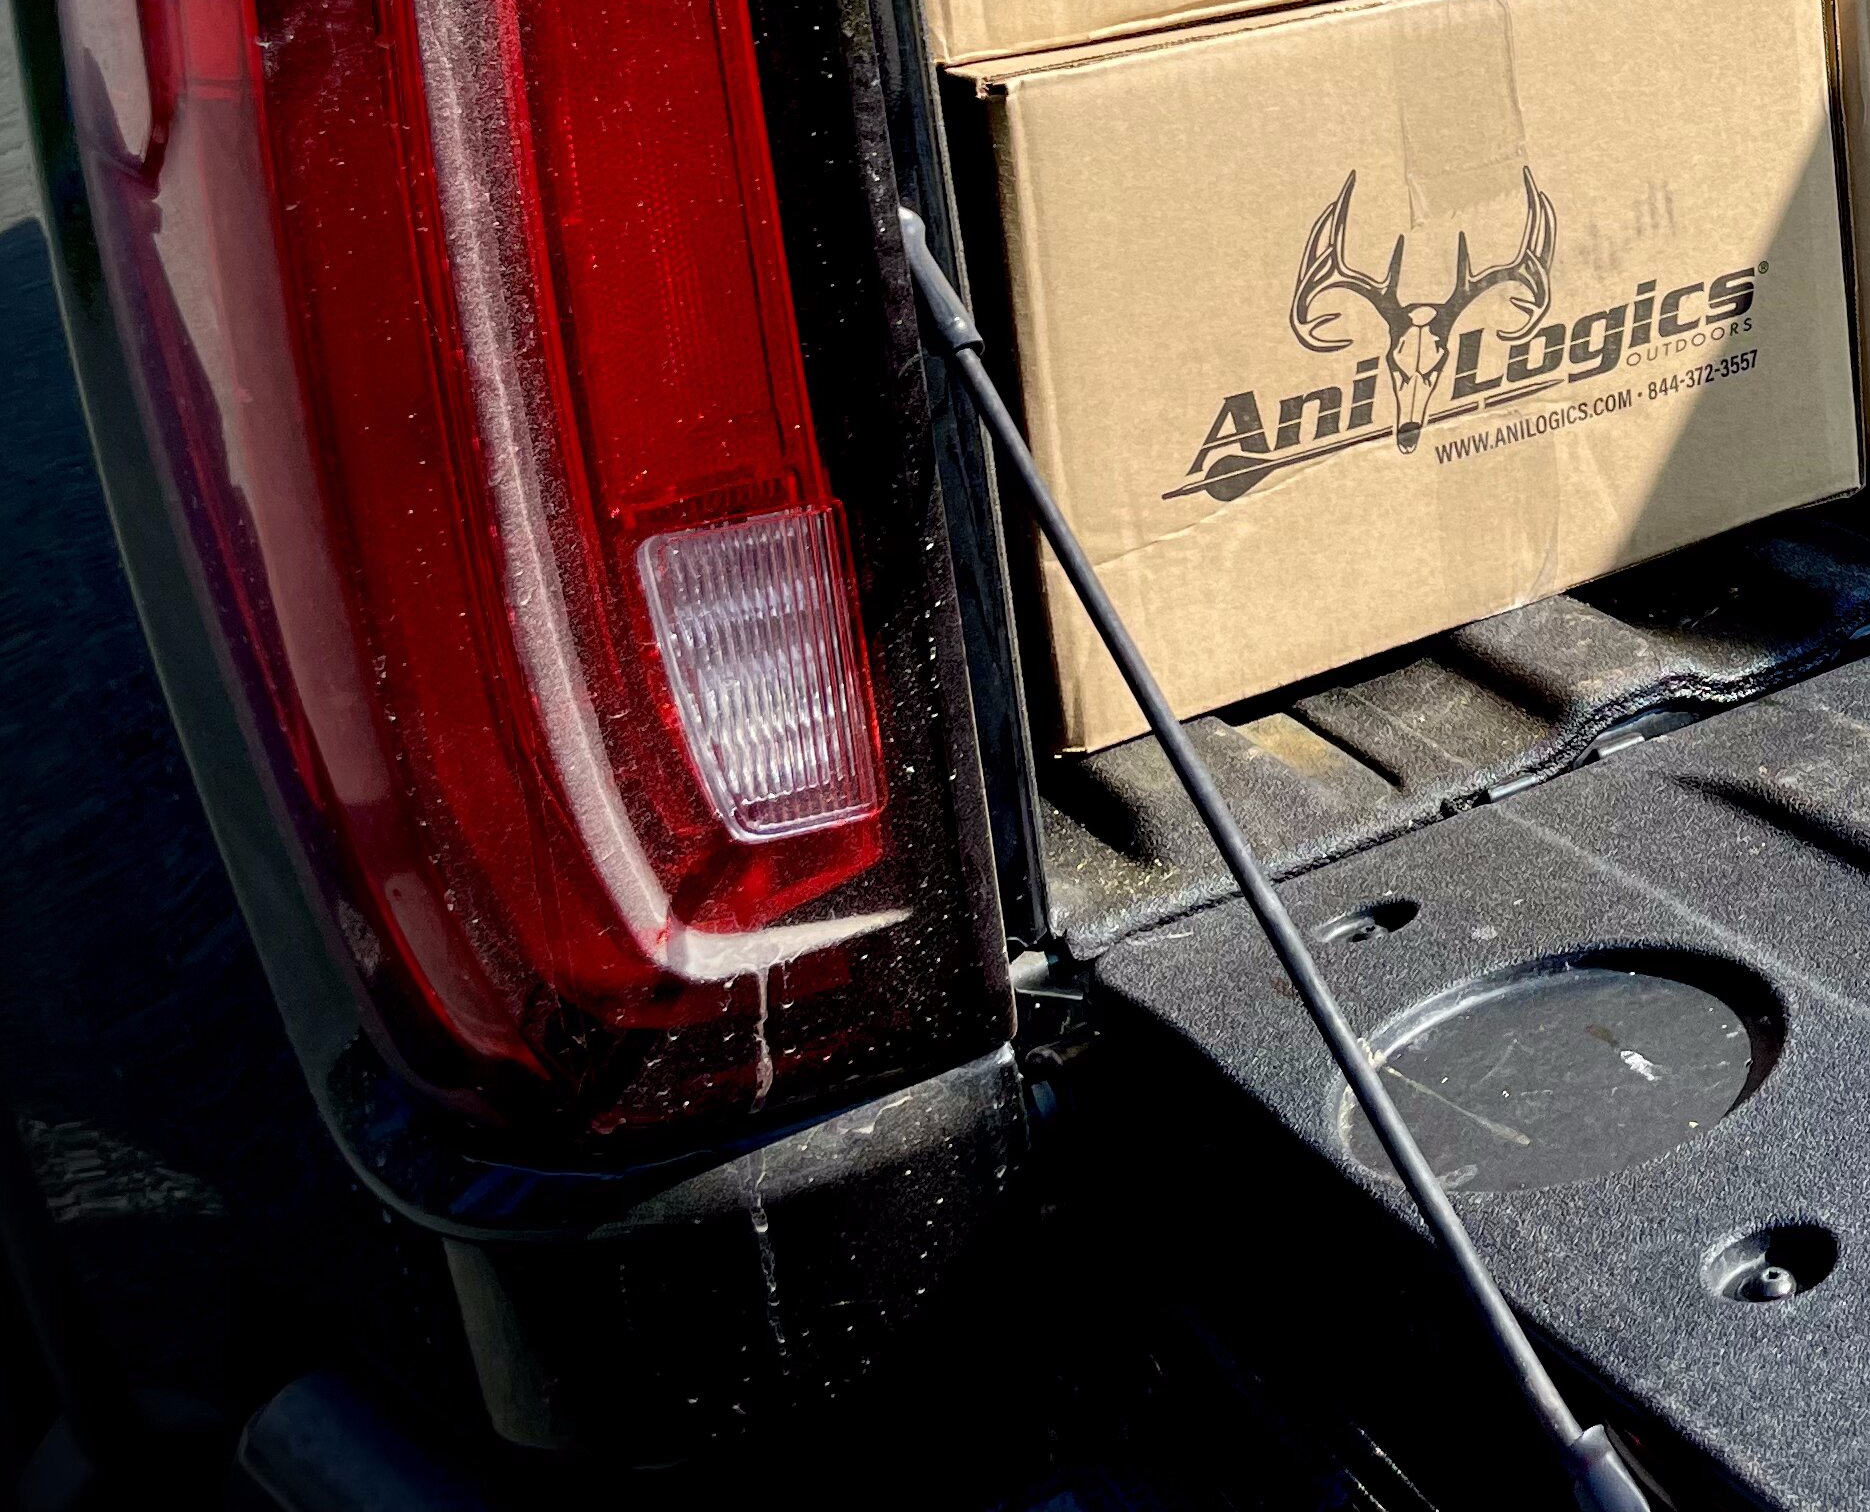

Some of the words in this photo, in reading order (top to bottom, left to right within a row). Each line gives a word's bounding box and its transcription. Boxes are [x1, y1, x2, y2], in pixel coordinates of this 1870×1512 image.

[1185, 354, 1381, 476] Ani
[1450, 266, 1755, 402] Logics
[1625, 316, 1755, 369] OUTDOORS
[1434, 388, 1634, 466] WWW.ANILOGICS.COM
[1646, 348, 1759, 404] 844-372-3557
